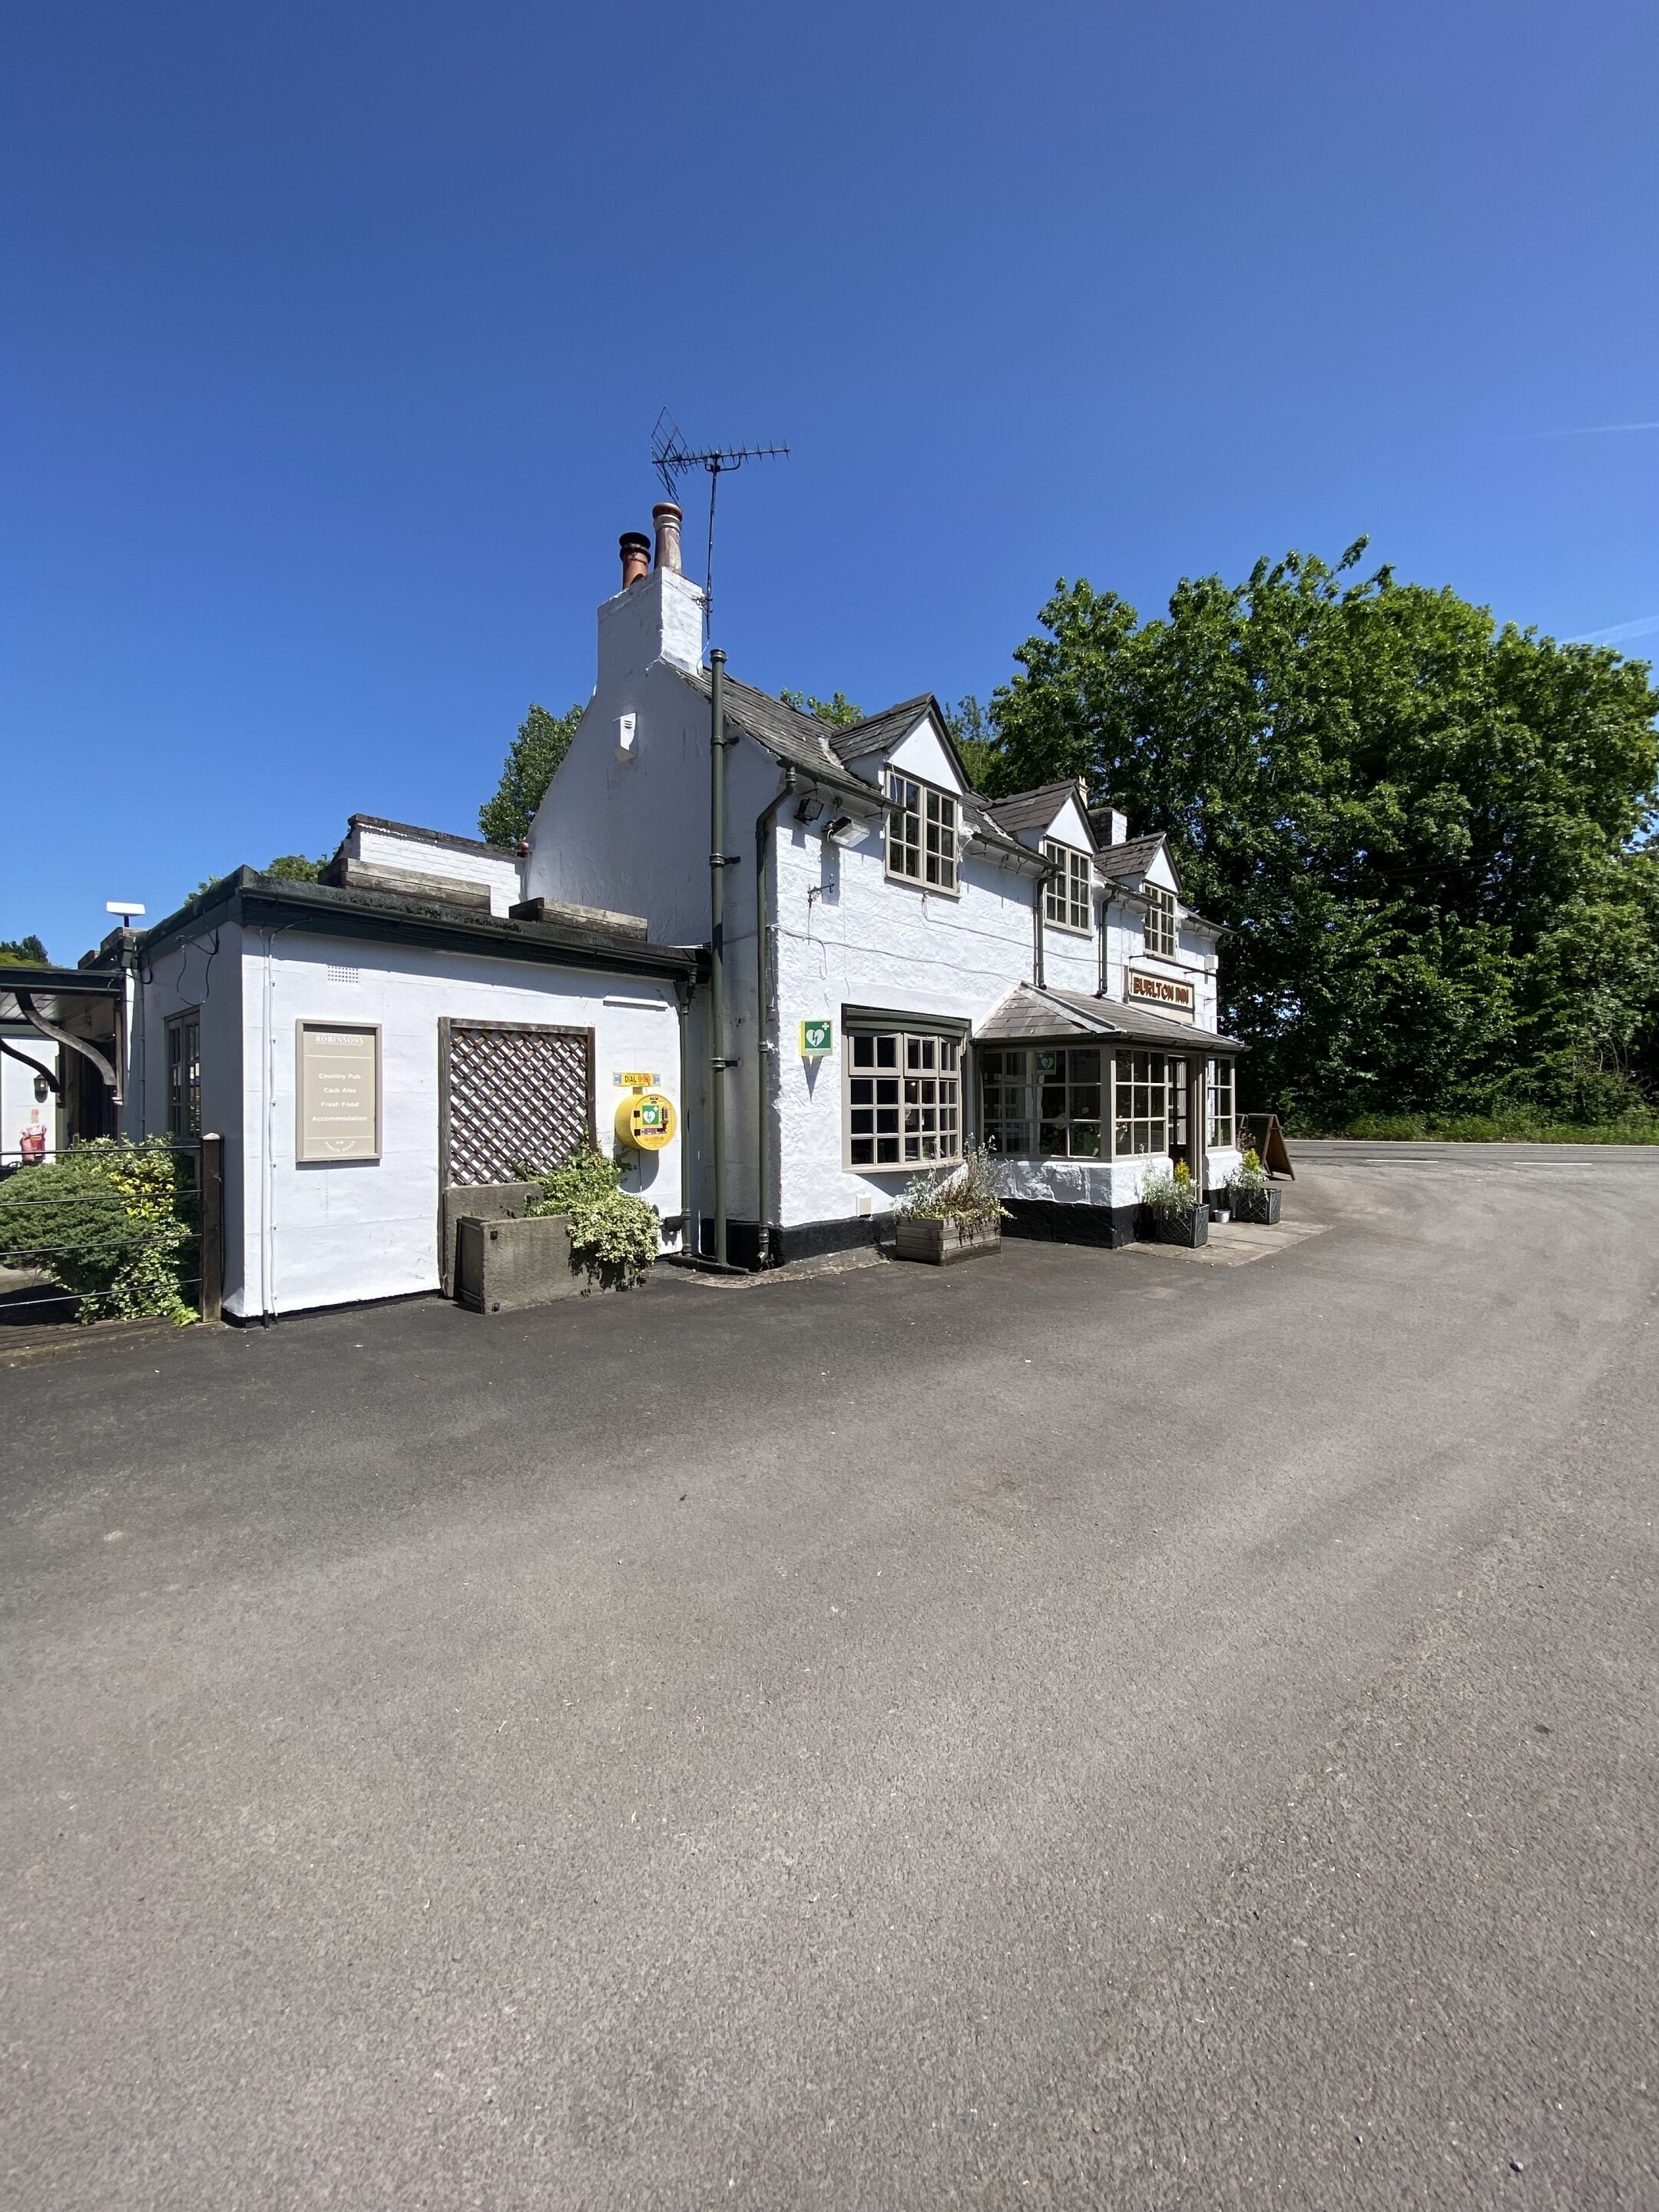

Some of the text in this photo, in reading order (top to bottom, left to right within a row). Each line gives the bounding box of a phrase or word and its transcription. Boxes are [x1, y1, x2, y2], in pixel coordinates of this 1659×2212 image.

[1134, 977, 1188, 1005] BURLTON INN
[316, 1035, 364, 1044] ROBINSONS
